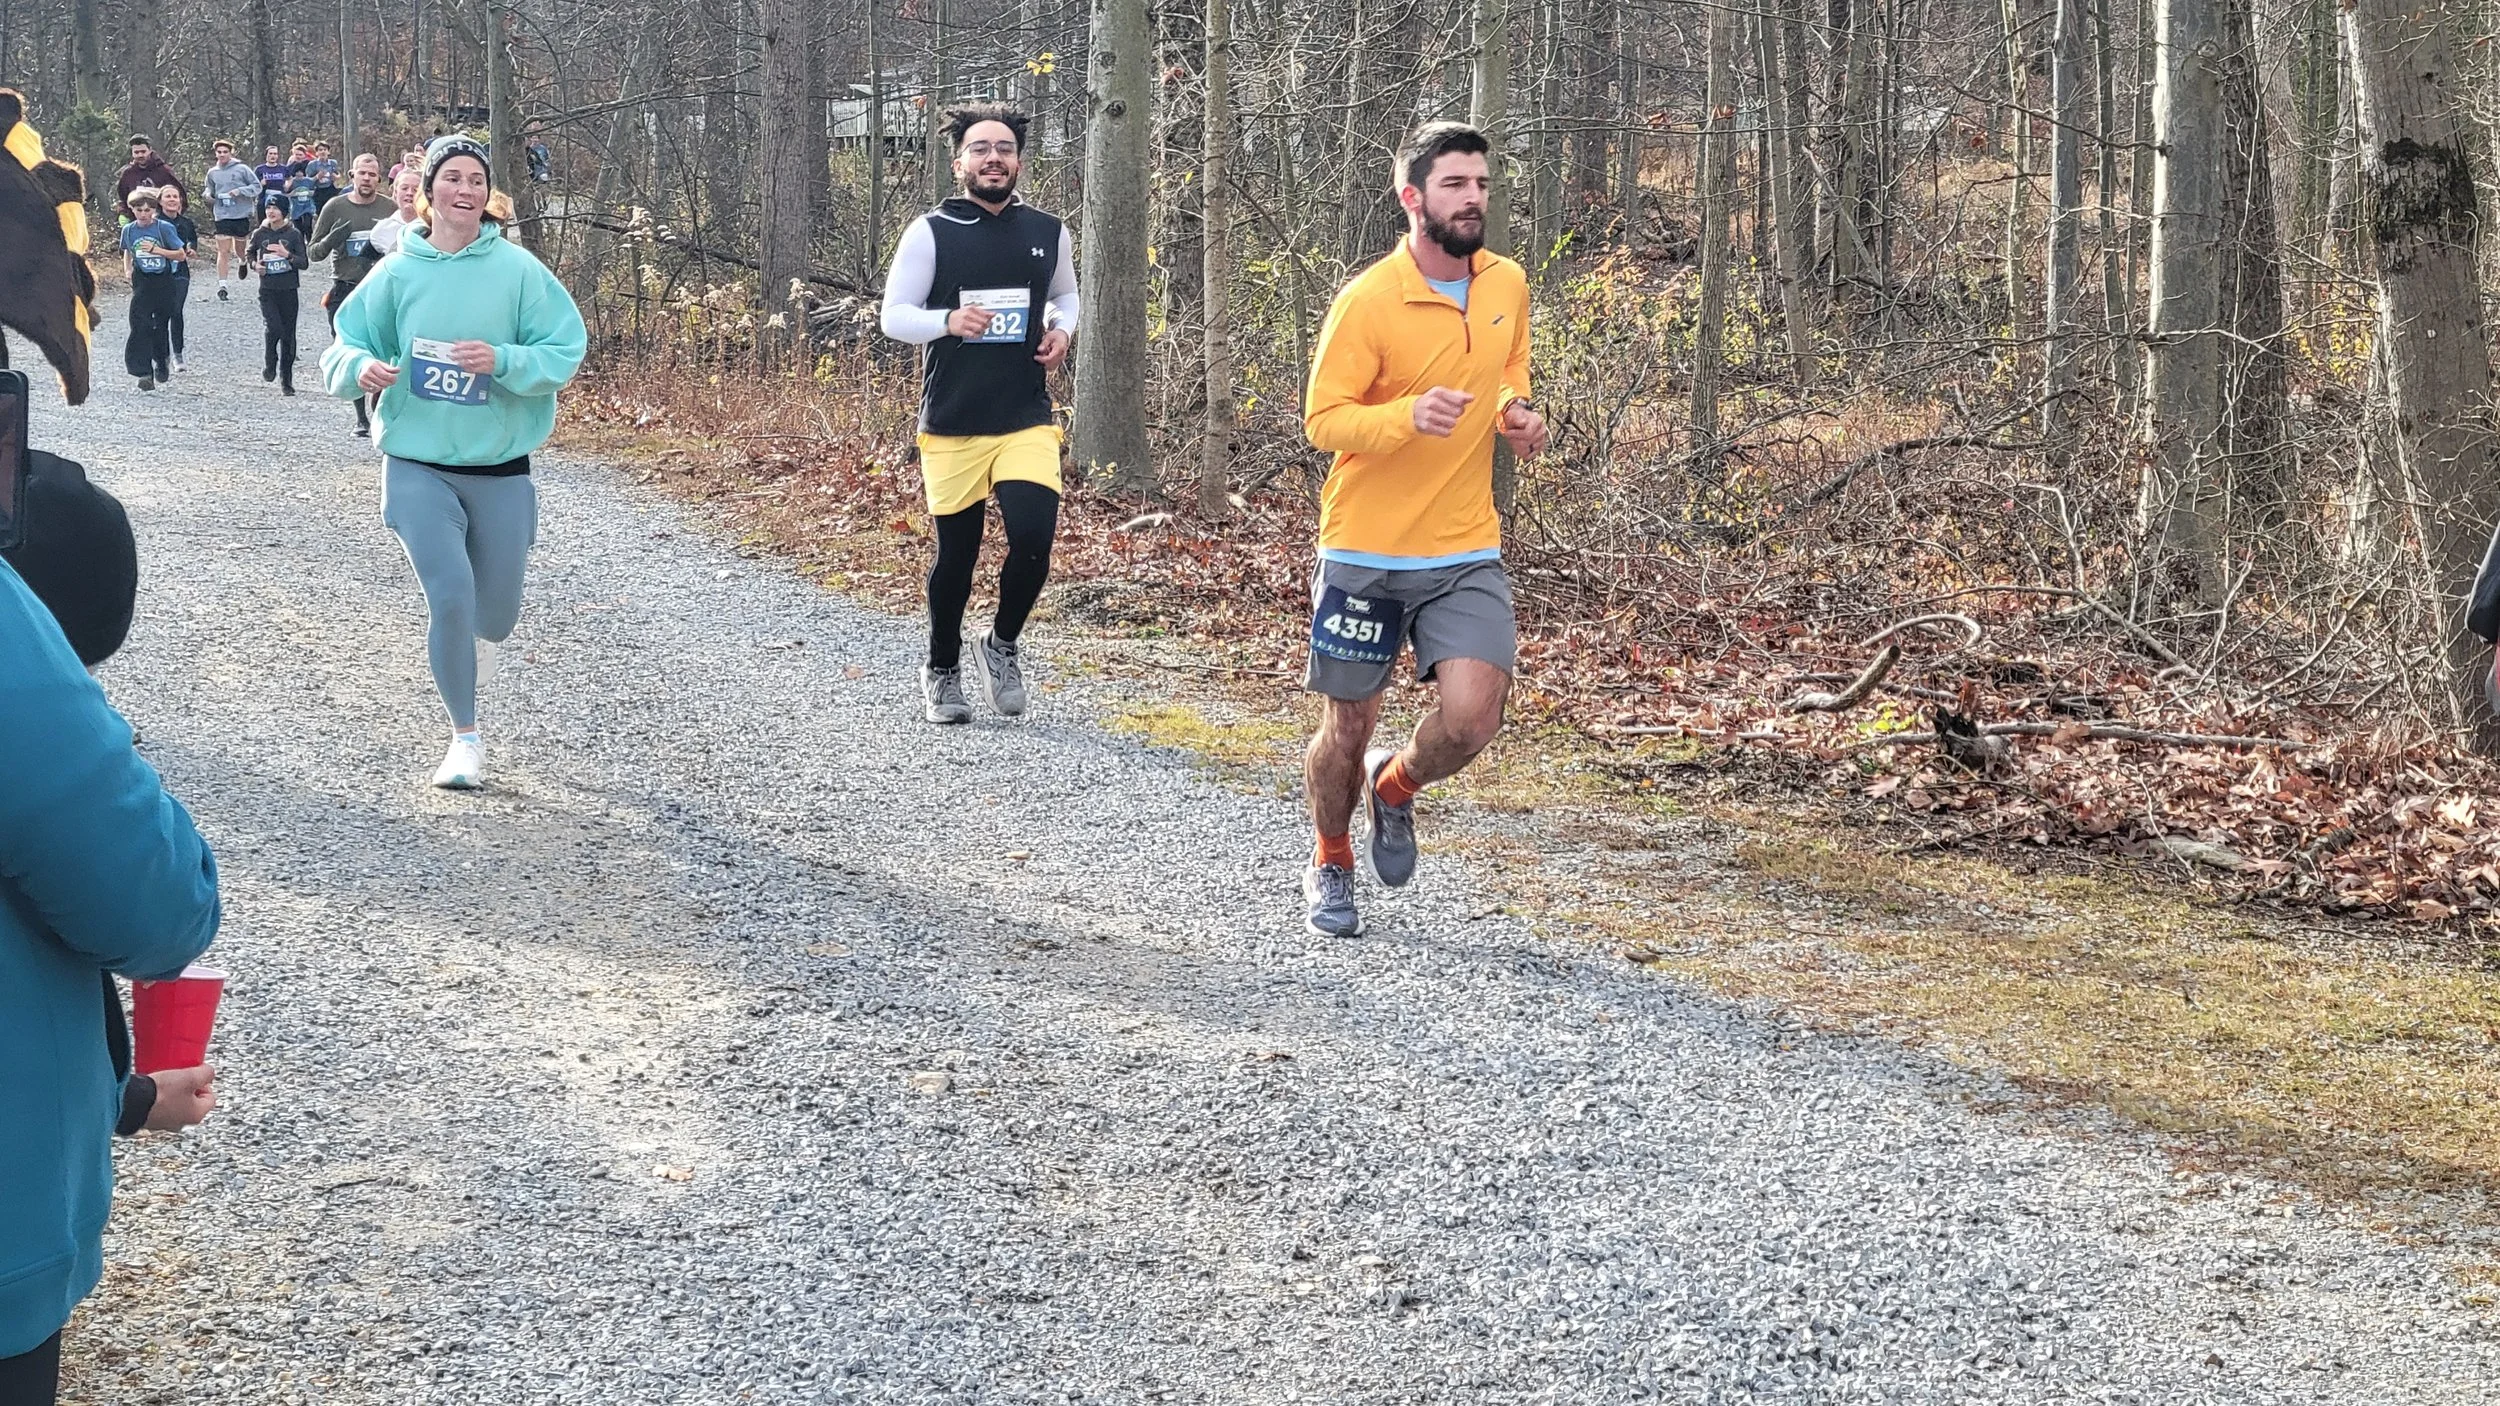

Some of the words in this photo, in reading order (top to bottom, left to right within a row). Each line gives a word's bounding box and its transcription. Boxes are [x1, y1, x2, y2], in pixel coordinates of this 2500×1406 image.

[141, 258, 161, 268] 343
[268, 261, 287, 270] 484
[984, 312, 1022, 335] 82
[424, 366, 476, 396] 267
[1323, 613, 1384, 644] 4351
